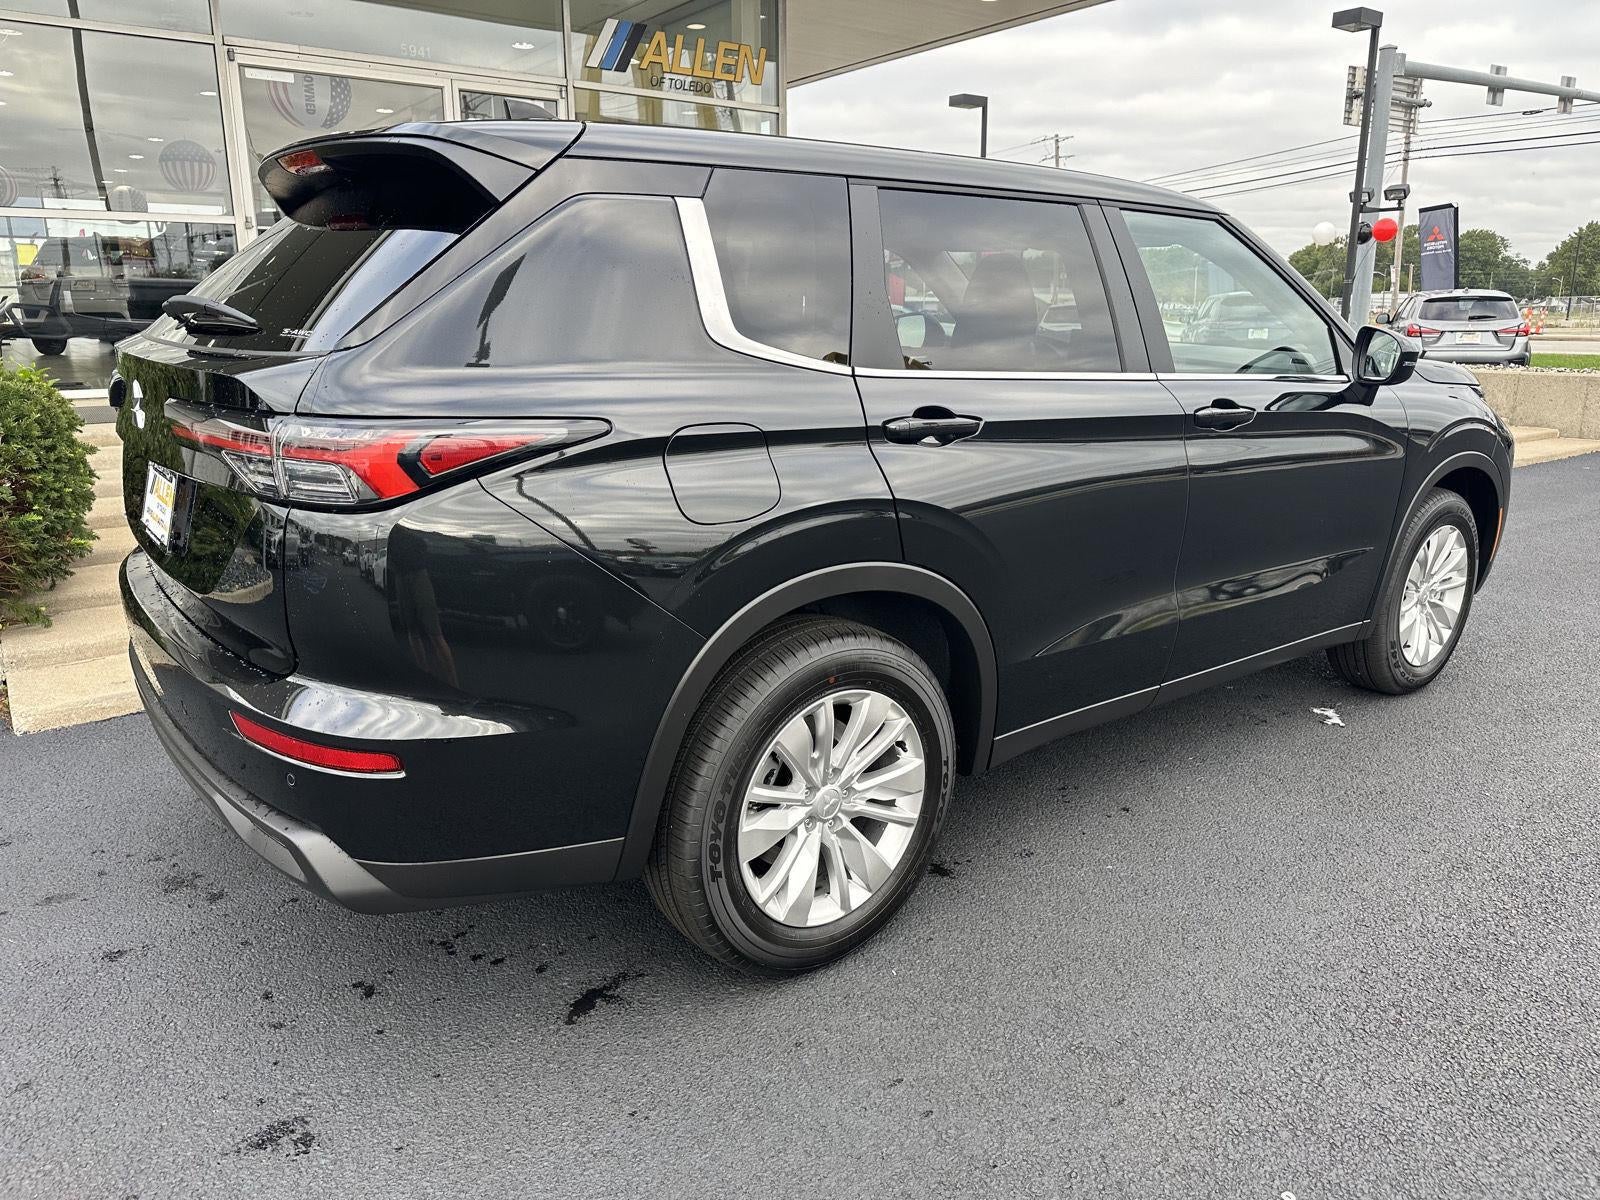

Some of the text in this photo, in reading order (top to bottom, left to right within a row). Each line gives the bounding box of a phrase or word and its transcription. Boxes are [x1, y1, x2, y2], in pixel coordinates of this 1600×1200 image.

[400, 43, 431, 58] 5941
[639, 31, 767, 86] ALLEN
[303, 75, 316, 115] OWNED
[650, 75, 711, 94] OF TOLEDO
[708, 799, 727, 883] TOYO
